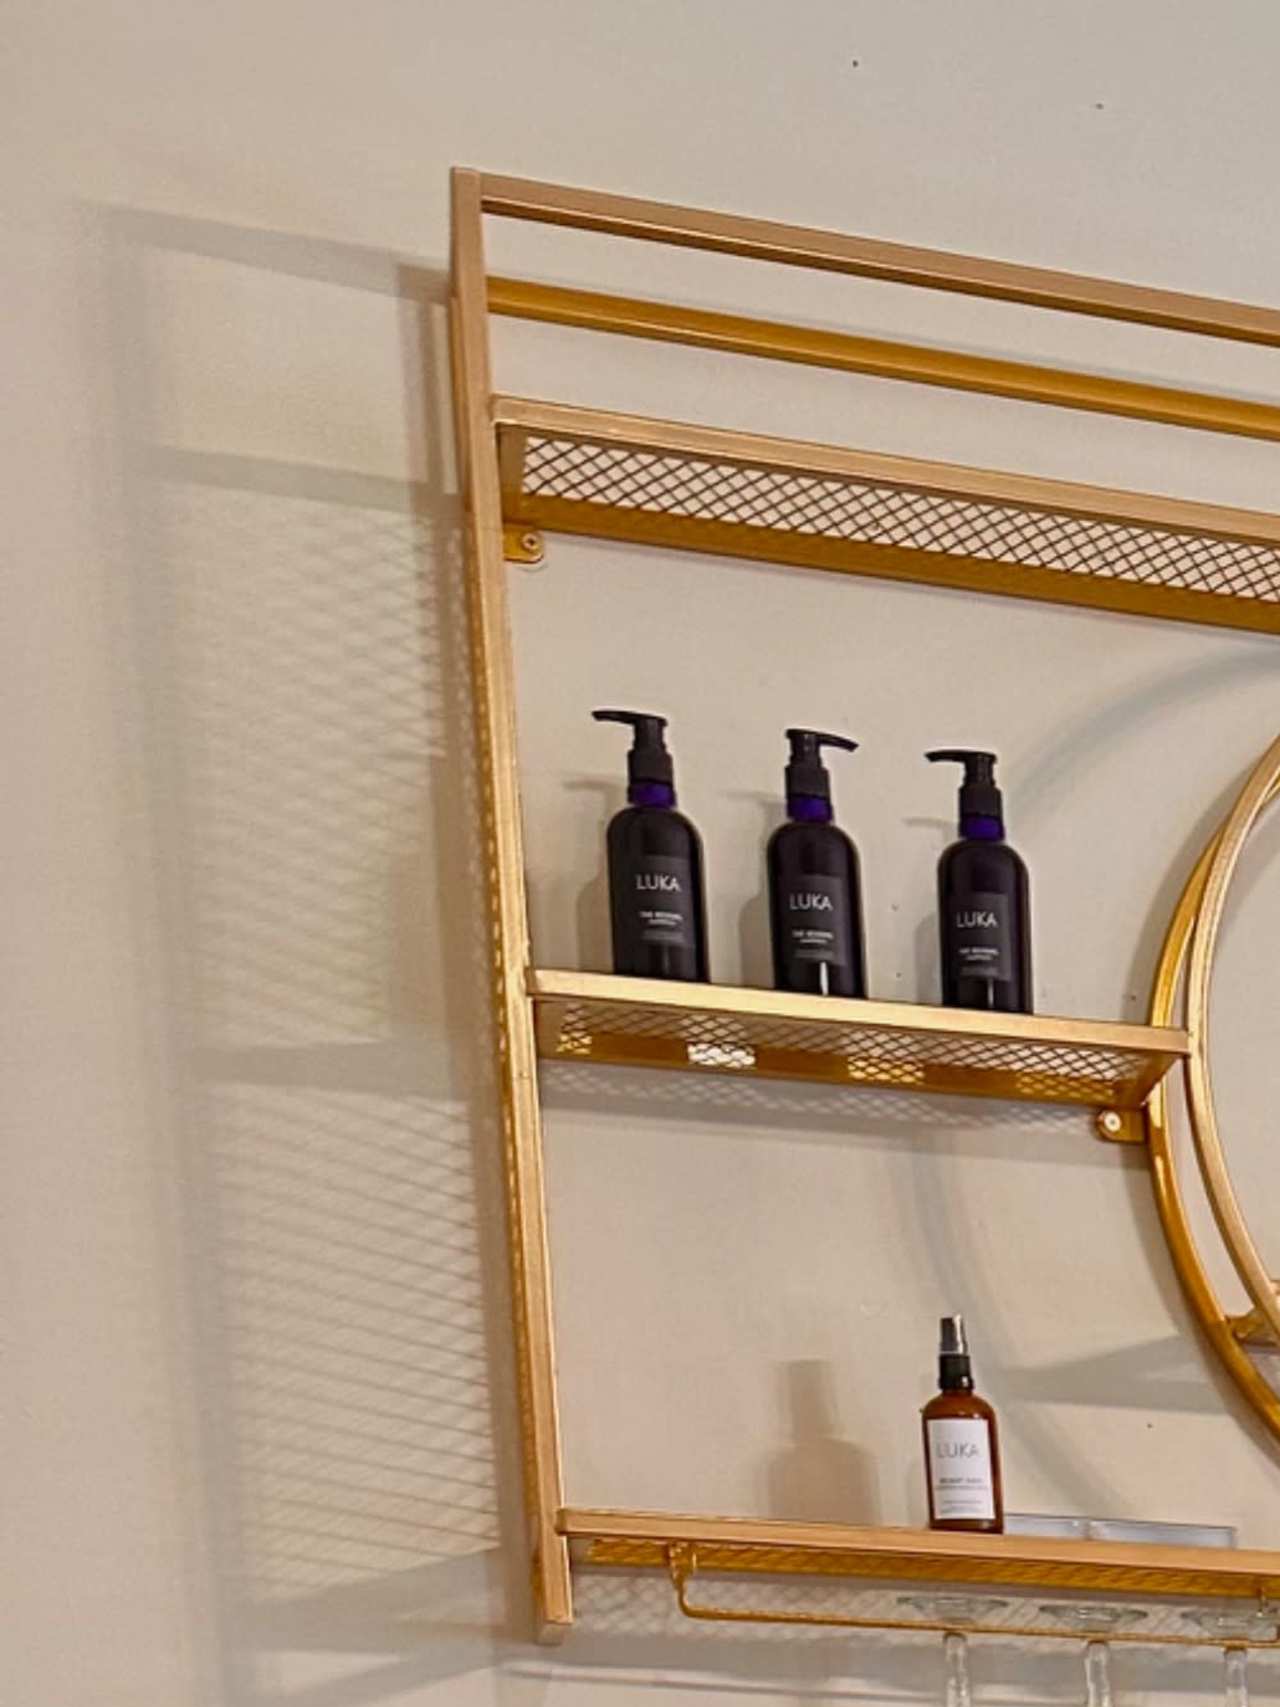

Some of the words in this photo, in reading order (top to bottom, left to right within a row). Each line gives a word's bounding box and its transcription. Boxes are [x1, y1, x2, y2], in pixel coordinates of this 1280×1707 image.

[636, 874, 682, 892] LUKA
[789, 893, 834, 912] LUKA
[956, 911, 999, 928] LUKA
[936, 1442, 980, 1459] LUKA
